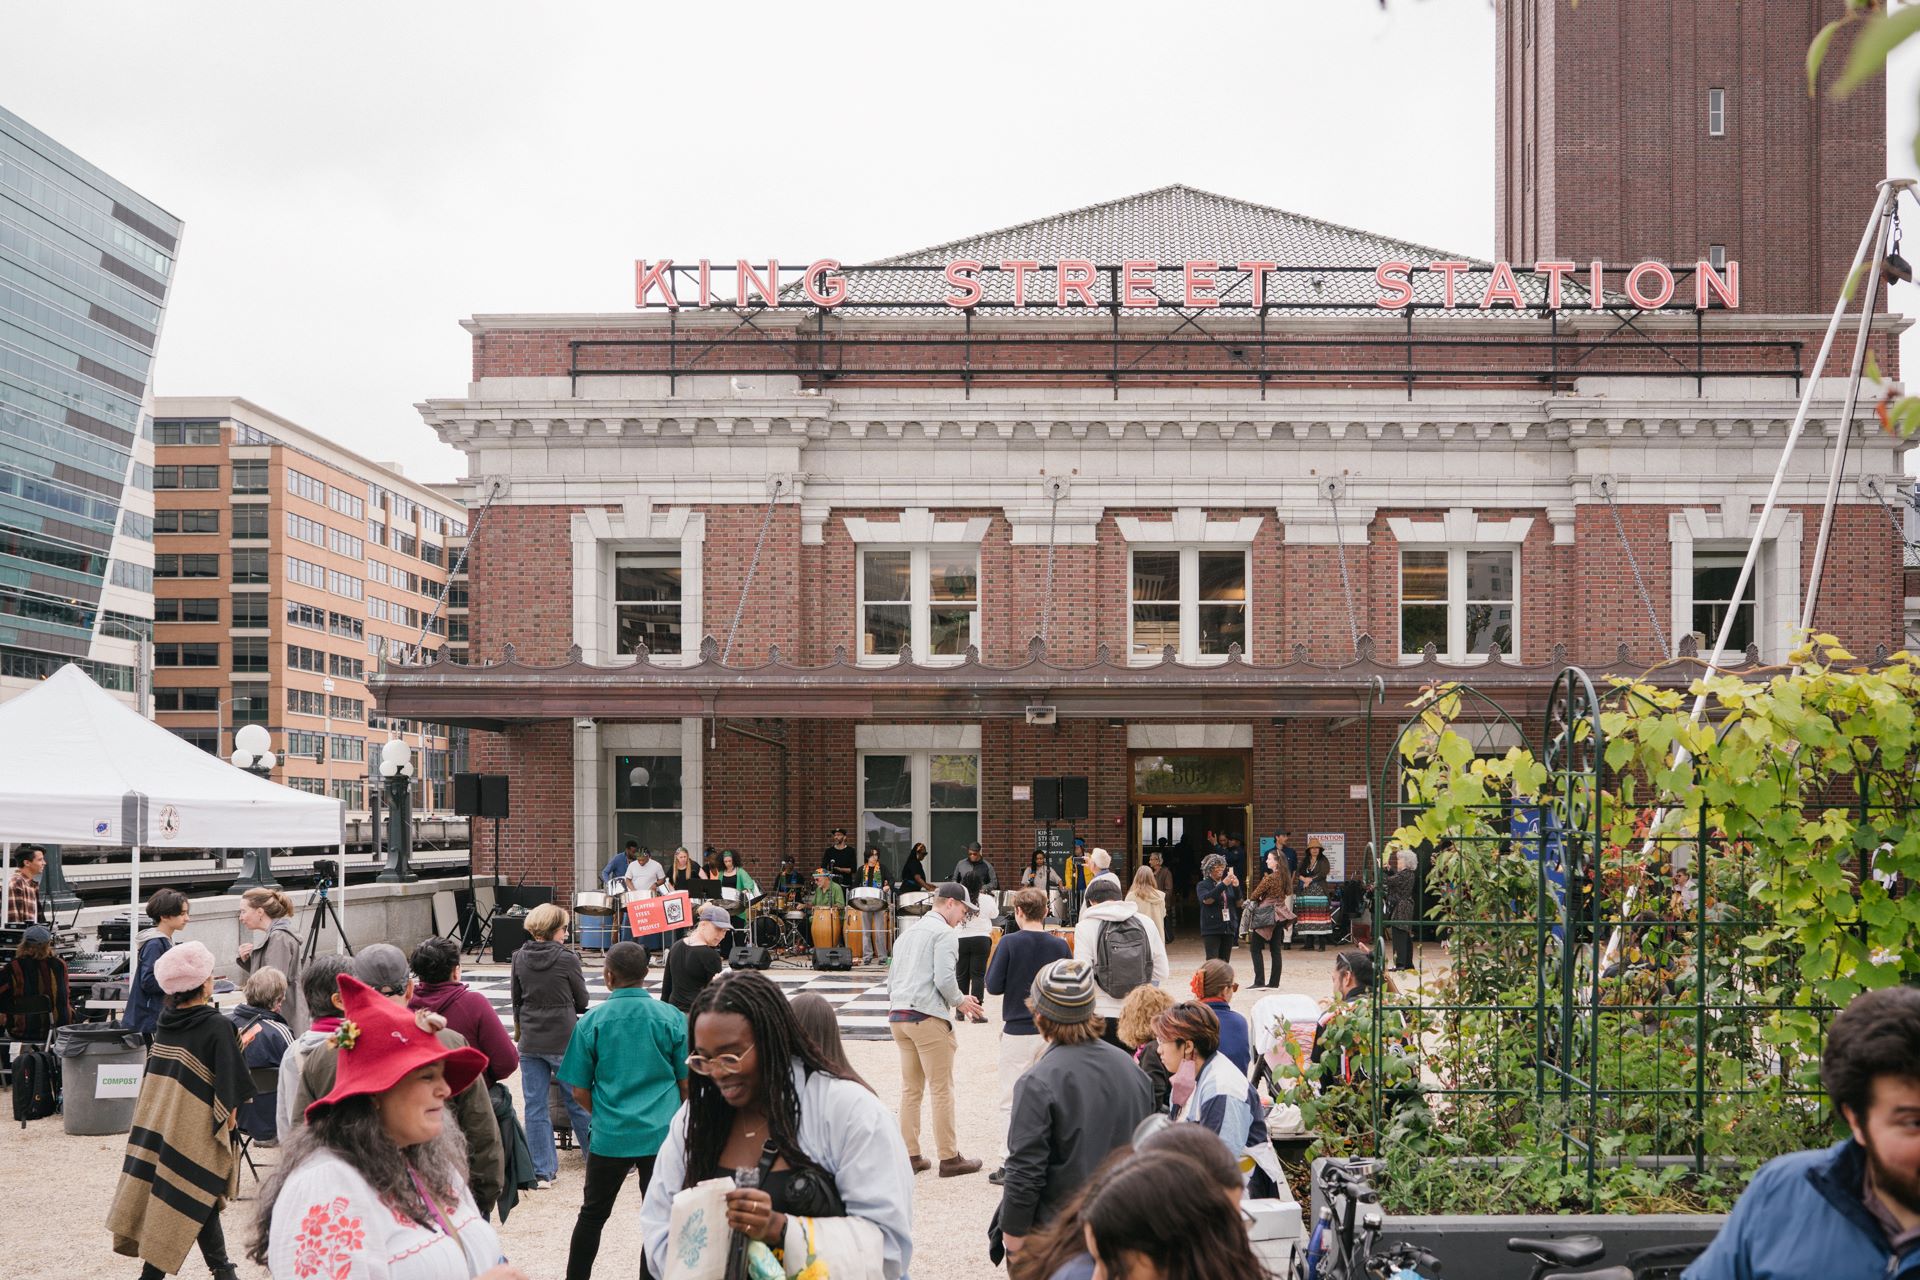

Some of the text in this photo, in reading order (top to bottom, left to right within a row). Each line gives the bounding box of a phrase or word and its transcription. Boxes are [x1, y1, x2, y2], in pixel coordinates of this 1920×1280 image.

[635, 258, 1739, 310] KING STREET STATION
[102, 1077, 138, 1085] COMPOST
